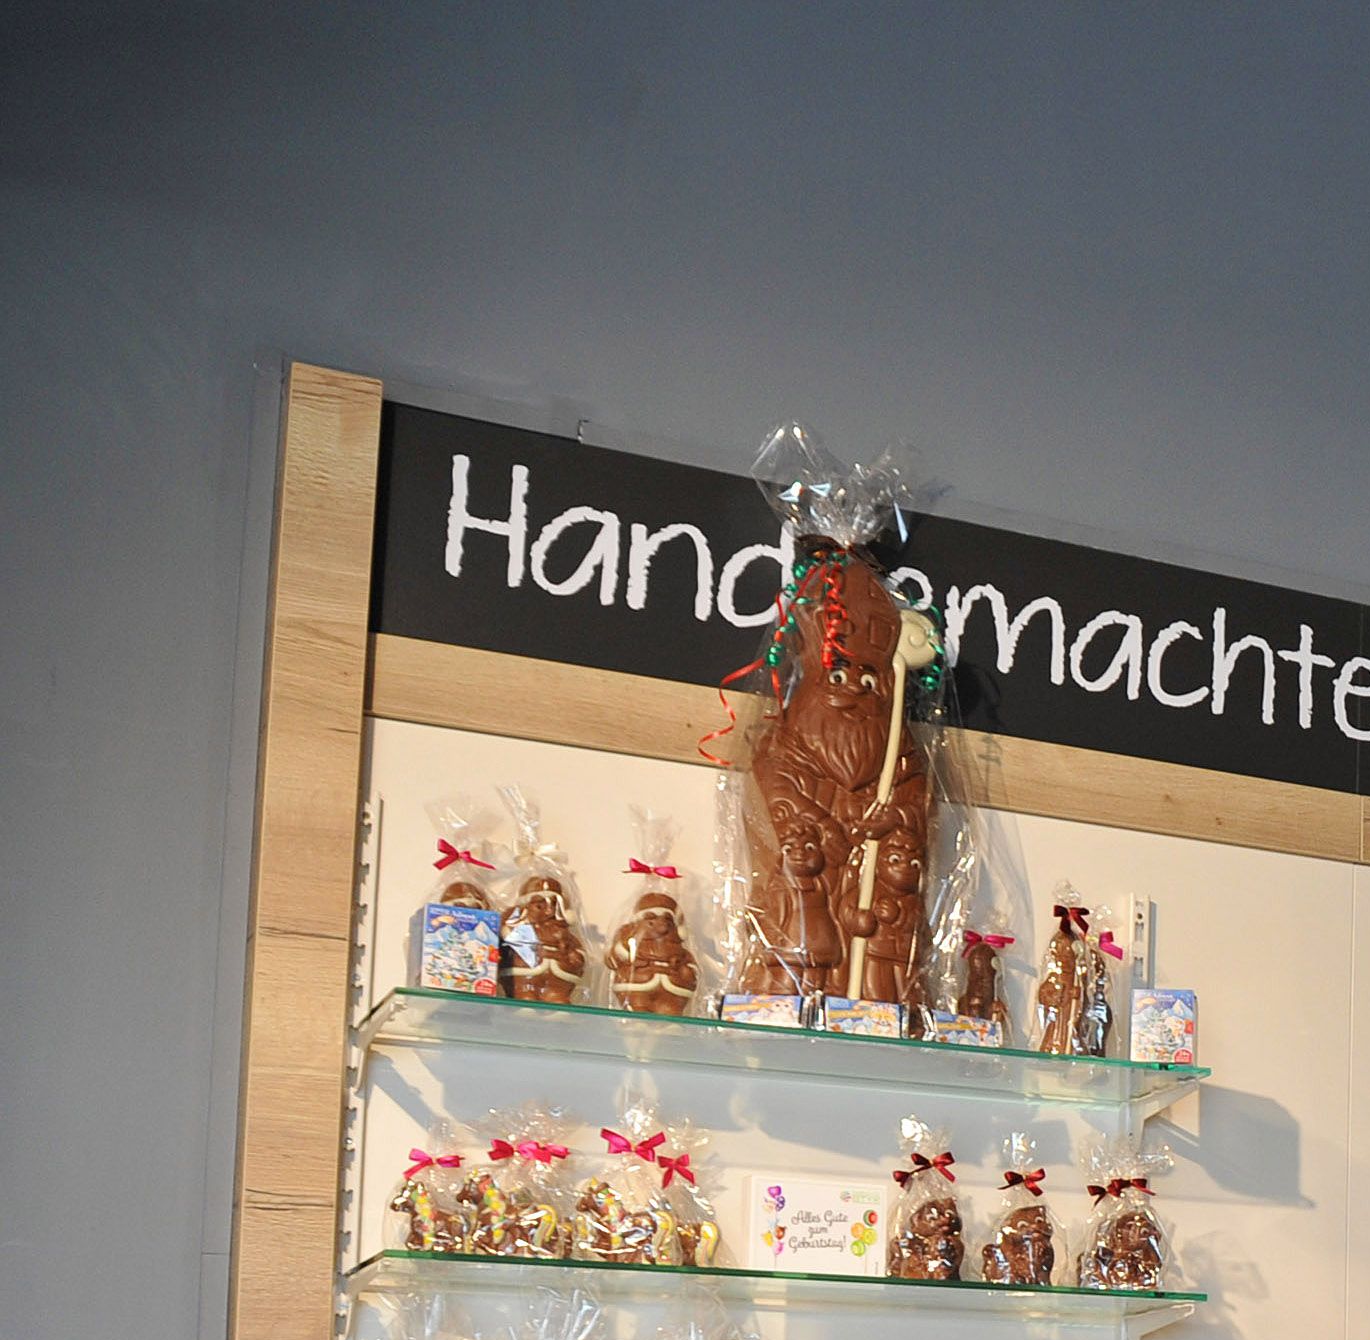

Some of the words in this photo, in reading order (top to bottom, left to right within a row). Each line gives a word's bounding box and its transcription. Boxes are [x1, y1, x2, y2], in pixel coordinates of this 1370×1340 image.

[791, 1209, 822, 1226] Alles
[824, 1209, 849, 1227] Gute
[808, 1226, 828, 1239] zum
[788, 1235, 847, 1254] Geburtstag!
